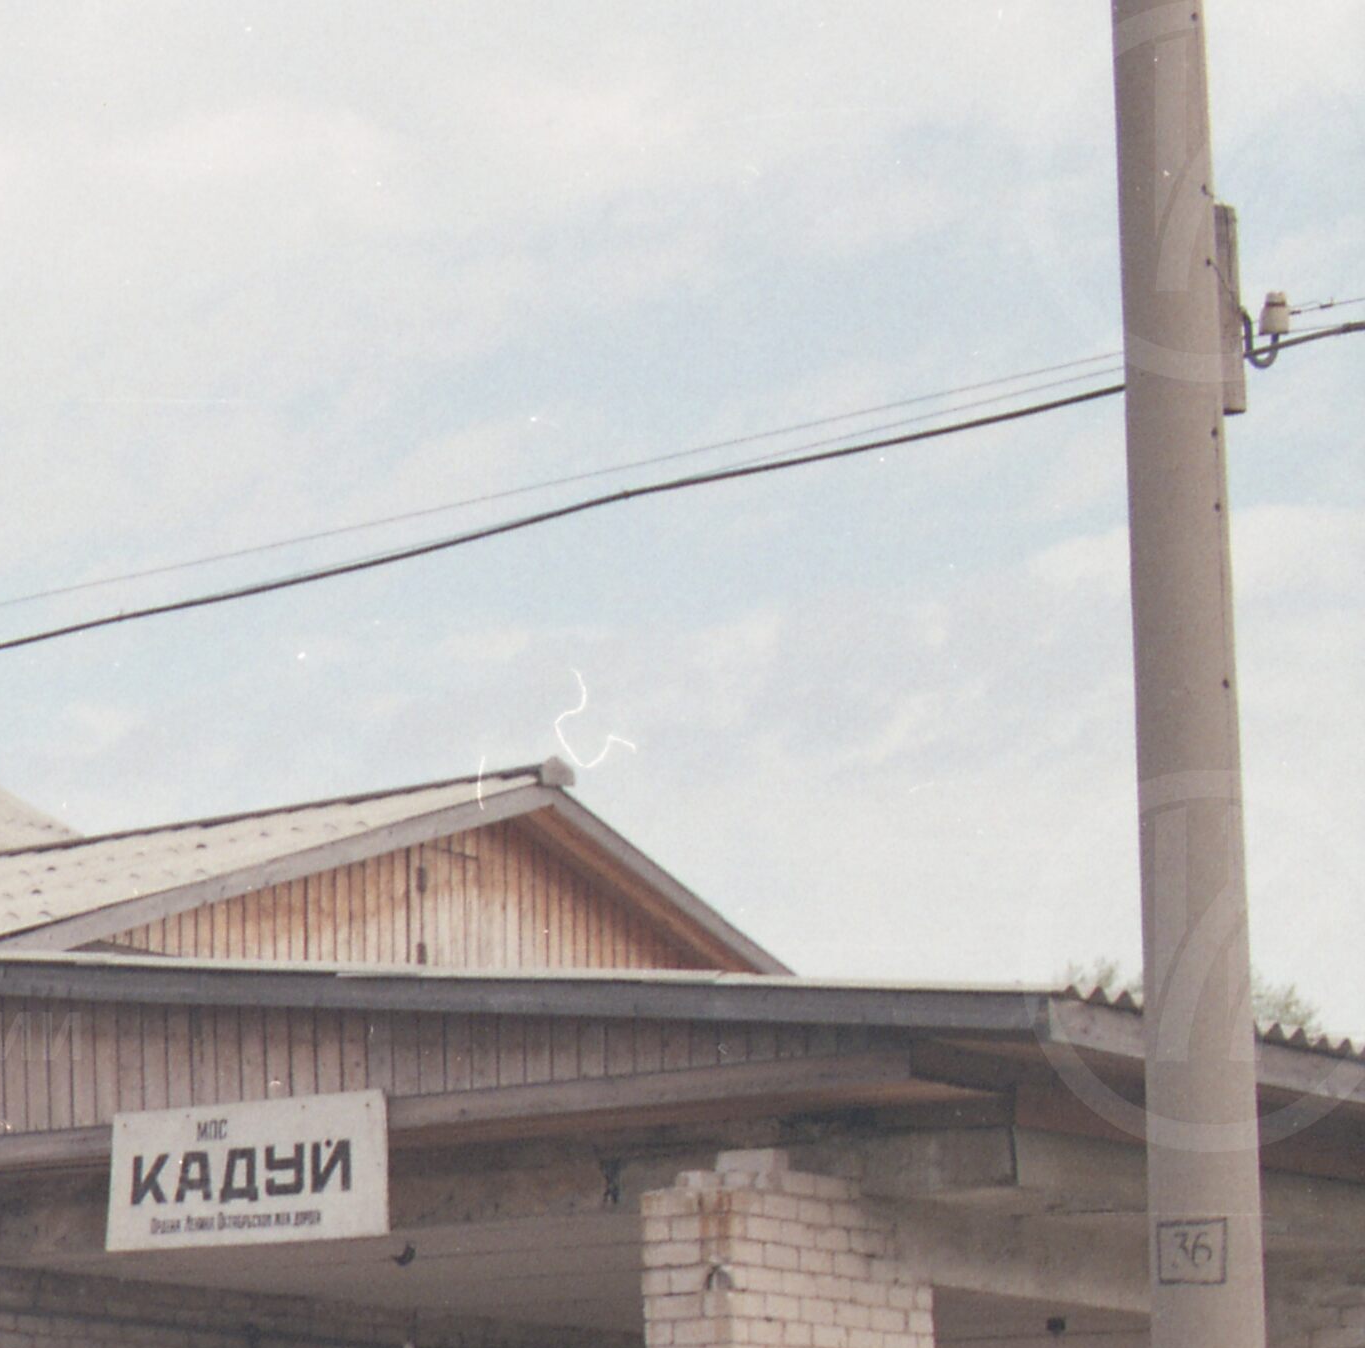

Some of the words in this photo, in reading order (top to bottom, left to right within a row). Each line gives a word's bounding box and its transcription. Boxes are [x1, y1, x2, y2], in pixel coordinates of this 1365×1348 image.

[196, 1118, 229, 1142] МПС
[130, 1138, 352, 1206] КАДУЙ
[1173, 1231, 1213, 1269] 36
